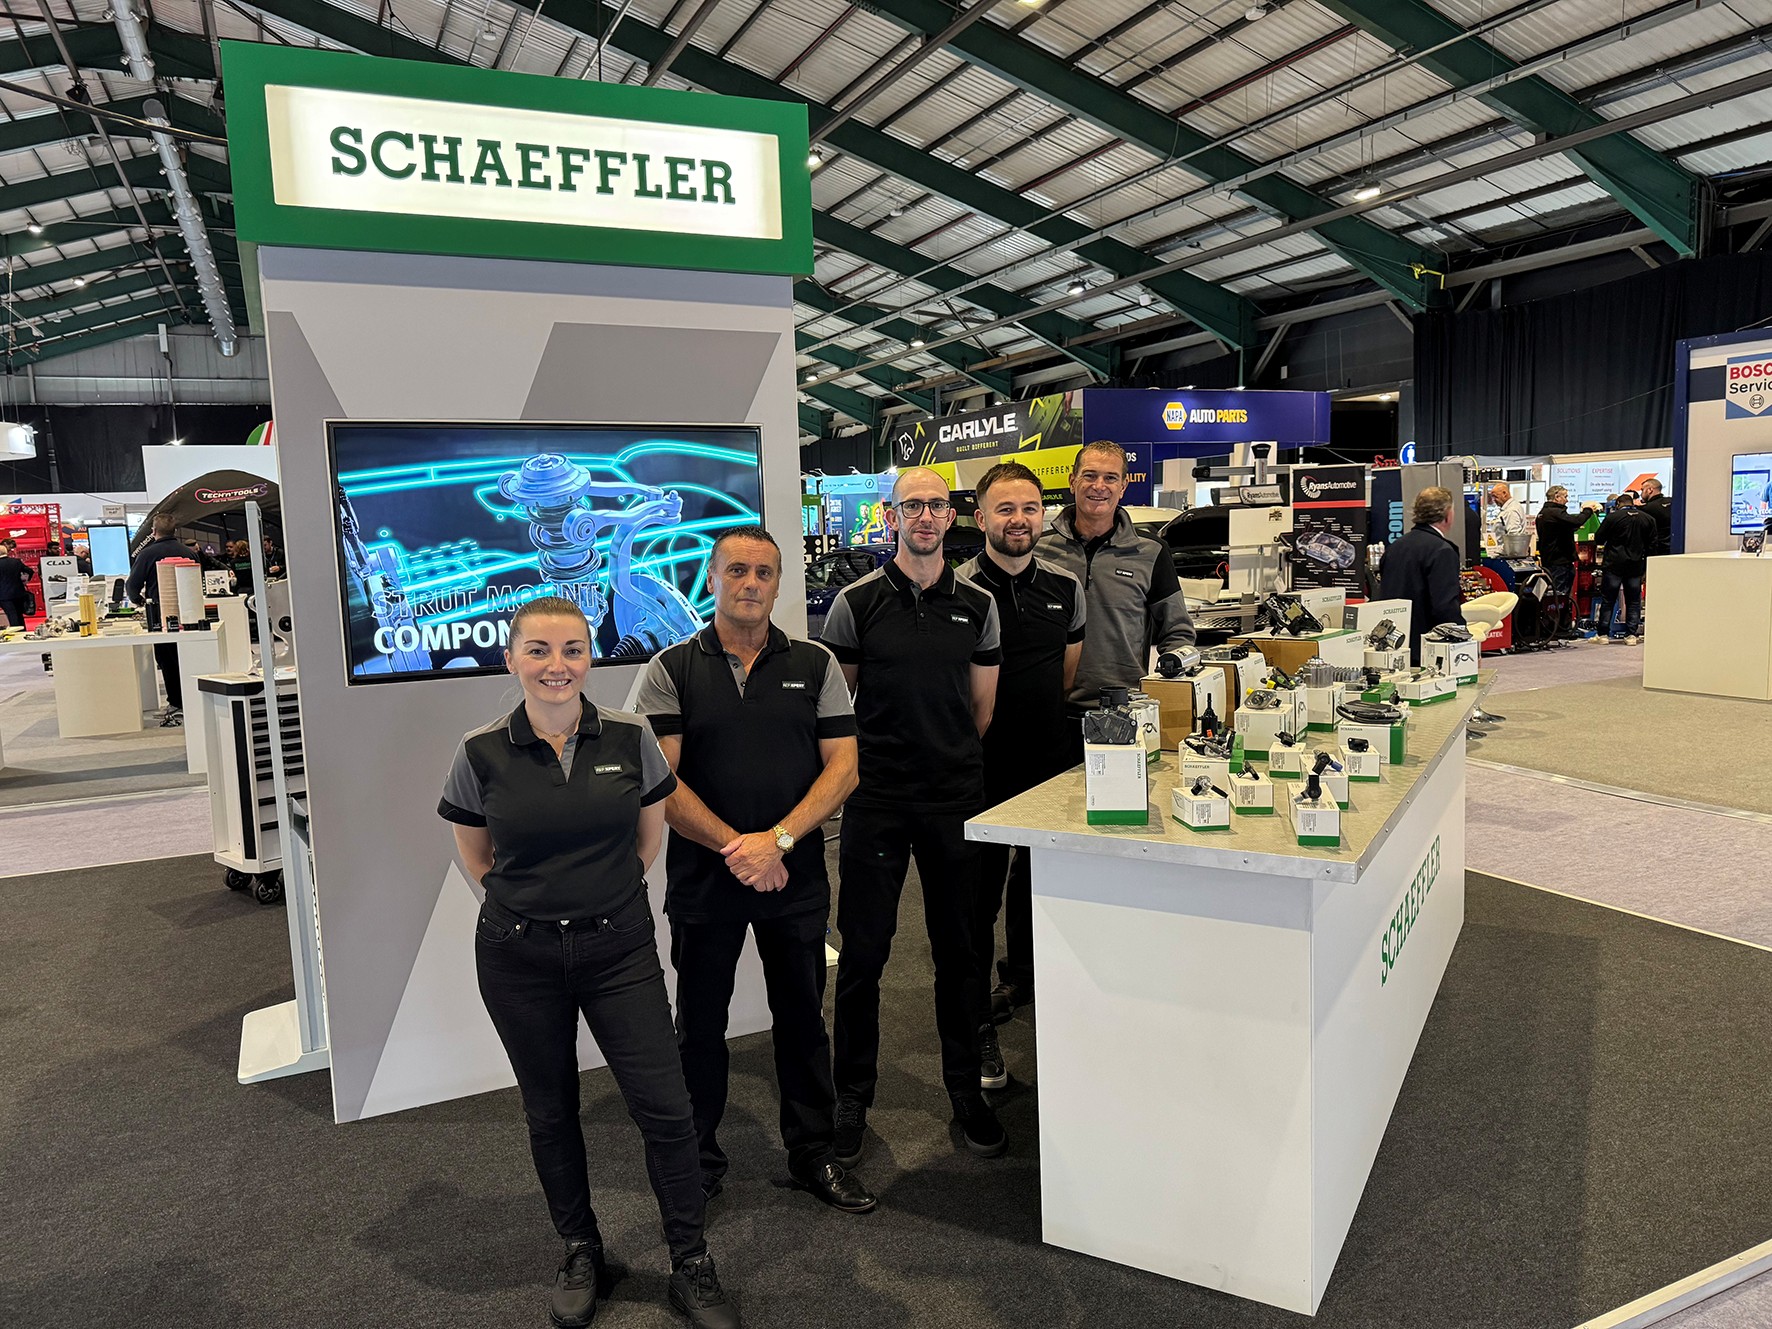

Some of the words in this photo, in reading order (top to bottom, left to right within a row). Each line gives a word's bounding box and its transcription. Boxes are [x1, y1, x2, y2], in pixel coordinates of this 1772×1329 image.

[329, 125, 736, 205] SCHAEFFLER
[1166, 410, 1183, 422] NAPA
[1189, 410, 1215, 423] AUTO
[1216, 409, 1248, 423] PARTS
[938, 412, 1019, 443] CARLYLE
[956, 445, 970, 453] BUILT
[1126, 473, 1146, 483] ALITY
[371, 588, 477, 619] STRUT
[1381, 834, 1441, 987] SCHAEFFLER
